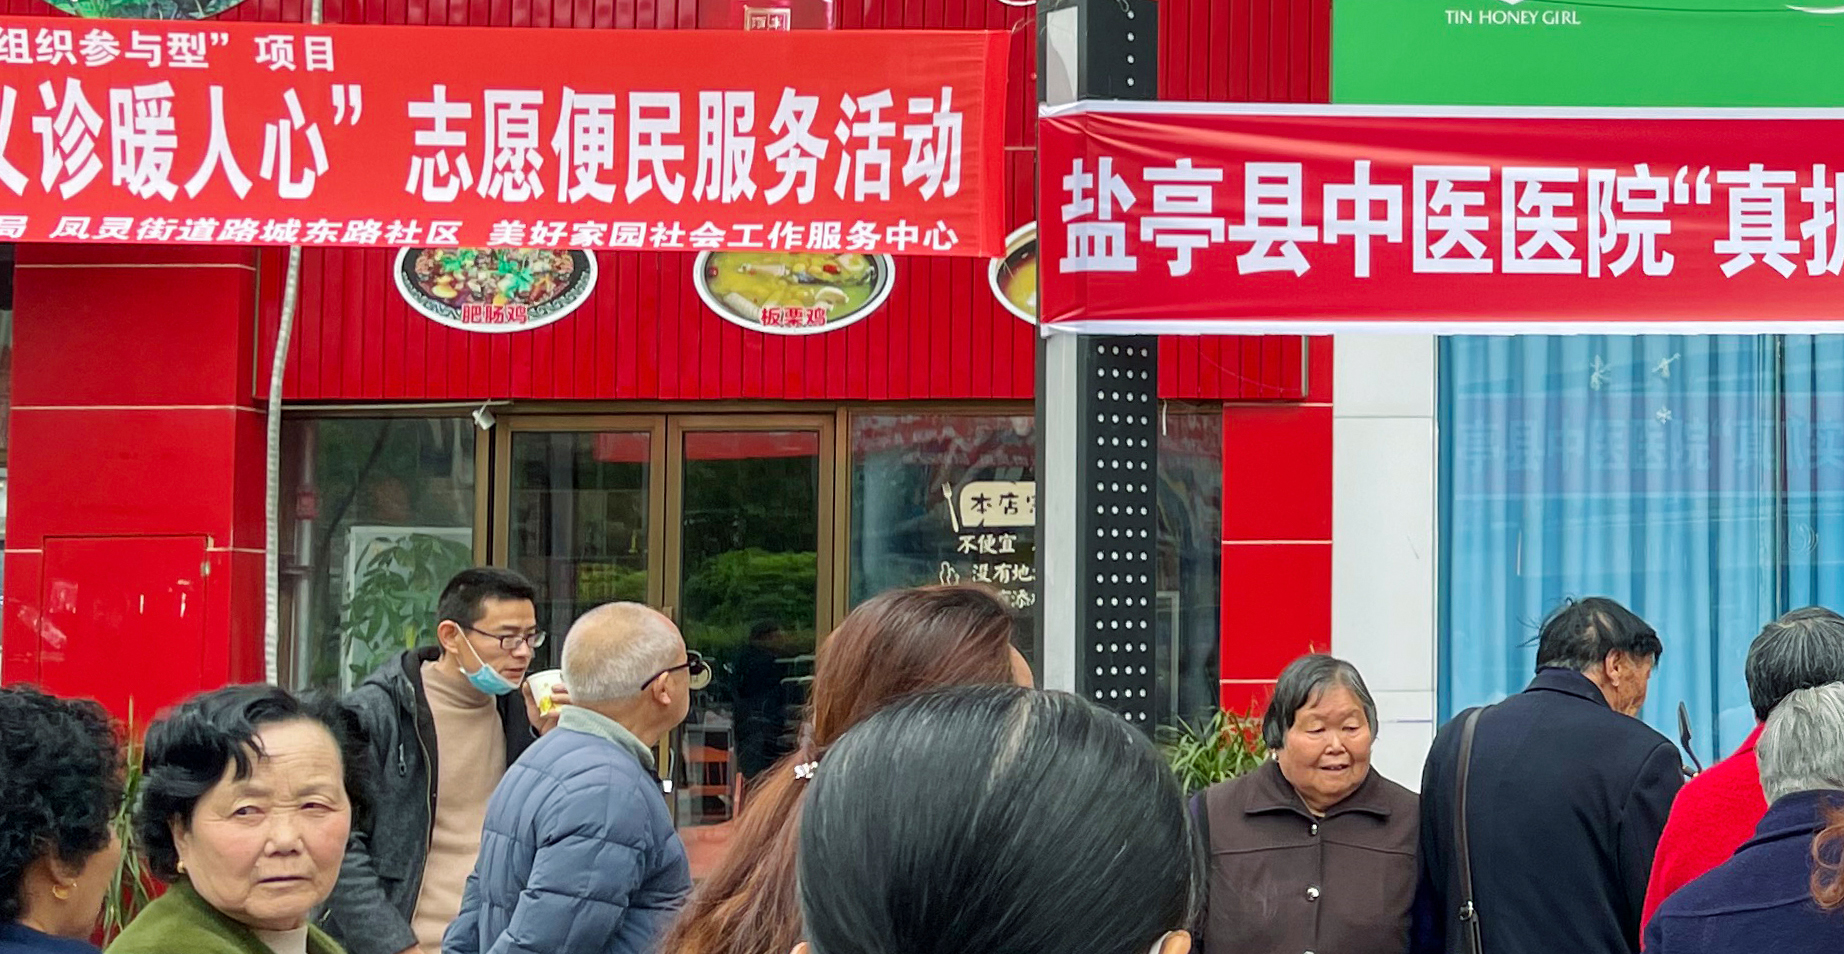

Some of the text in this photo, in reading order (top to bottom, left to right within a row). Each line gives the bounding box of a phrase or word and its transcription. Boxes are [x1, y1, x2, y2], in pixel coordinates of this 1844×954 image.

[1445, 10, 1581, 25] TIN HONEY GIRL
[254, 34, 335, 72] 项目
[404, 83, 964, 205] 志愿便民服务活动
[49, 215, 464, 246] 凤灵街道路城东路社区
[488, 219, 960, 252] 美好家园社会工作服务中心
[461, 303, 528, 325] 肥肠鸡
[760, 305, 827, 328] 板栗鸡
[957, 533, 1018, 555] 不便宜
[971, 563, 1036, 584] 没有地
